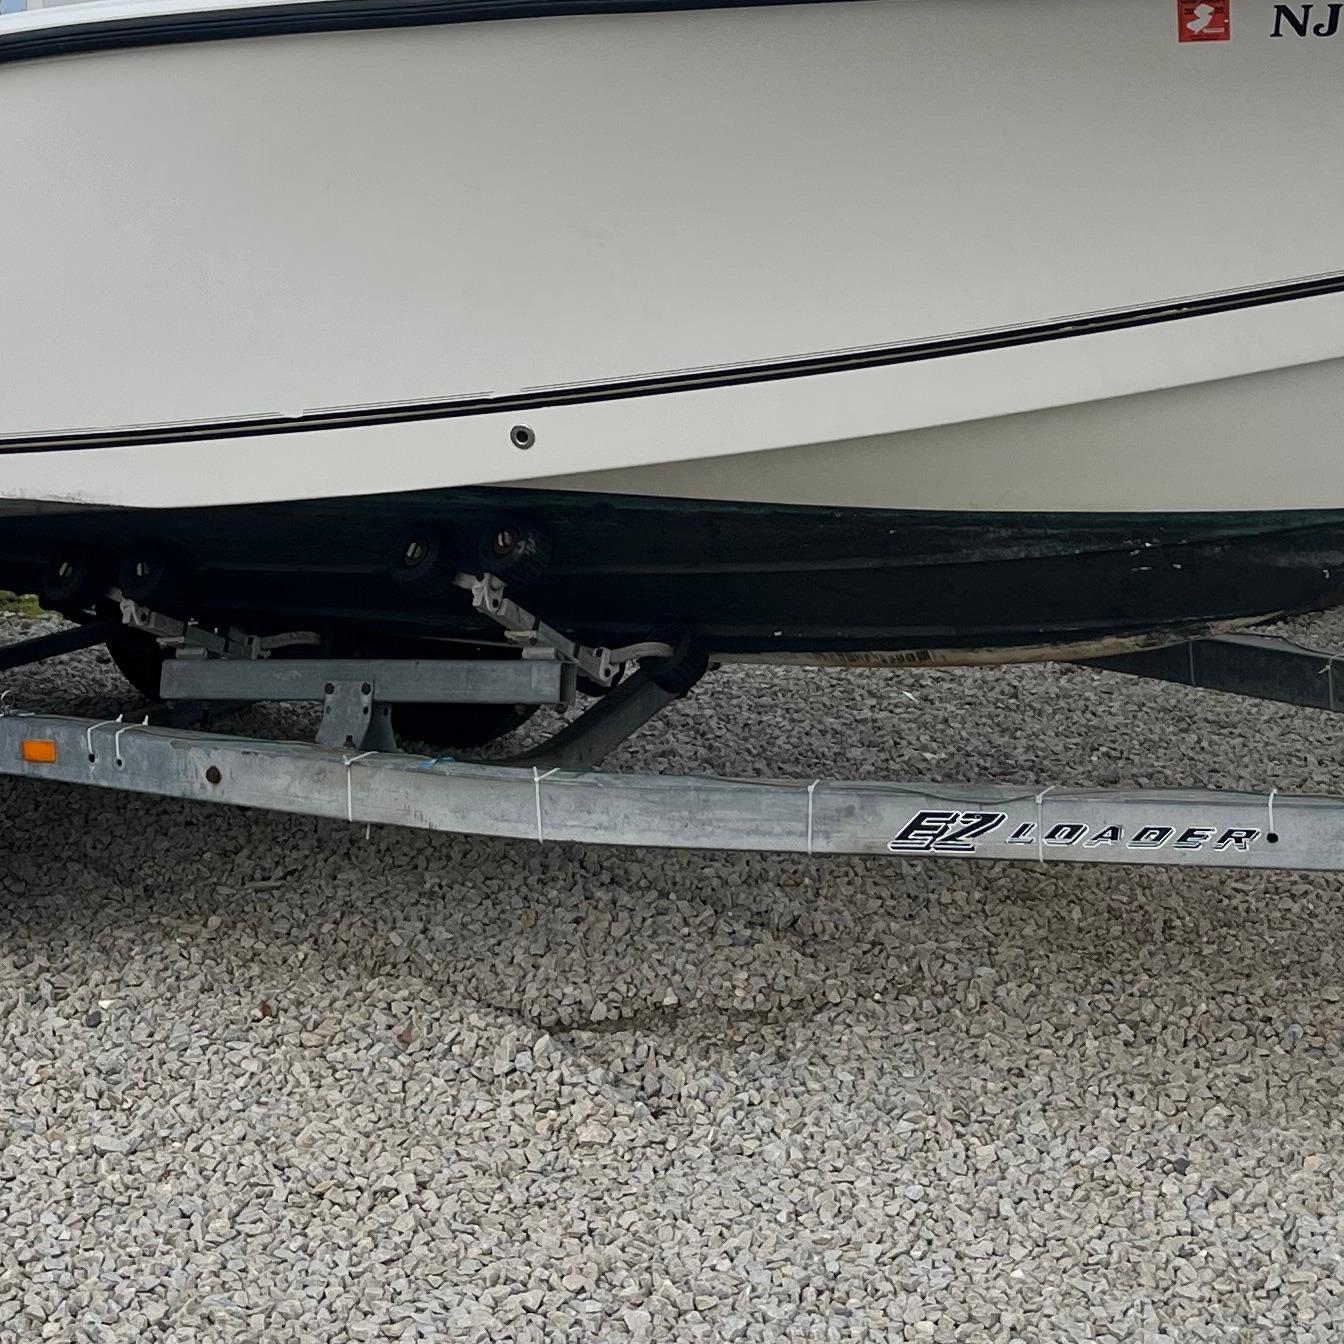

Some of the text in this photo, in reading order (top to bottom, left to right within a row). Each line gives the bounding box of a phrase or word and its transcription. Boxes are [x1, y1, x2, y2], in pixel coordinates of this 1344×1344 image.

[1270, 3, 1344, 38] NJ
[888, 810, 1260, 852] EZ LOADER
